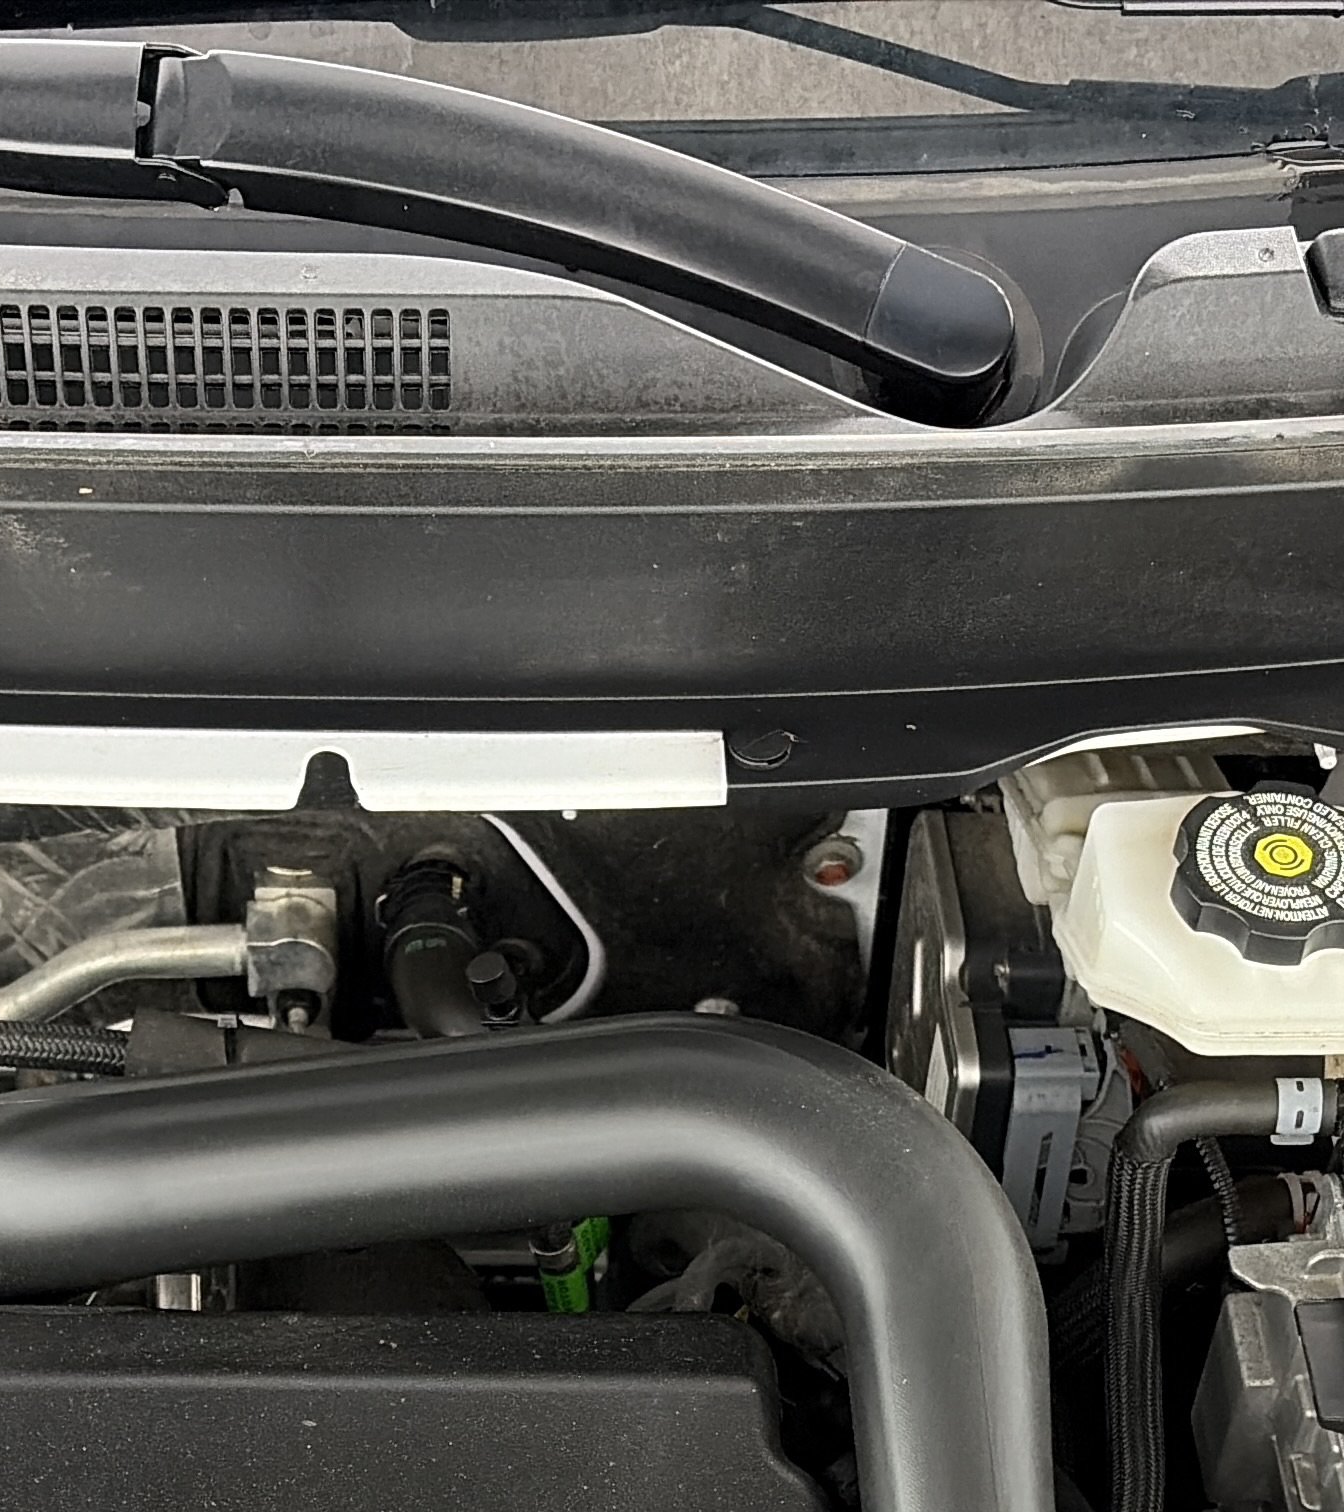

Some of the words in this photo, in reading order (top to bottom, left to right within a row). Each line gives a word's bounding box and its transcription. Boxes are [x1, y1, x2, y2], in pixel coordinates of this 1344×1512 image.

[1256, 804, 1284, 816] ONLY
[1285, 806, 1308, 819] USE
[1262, 816, 1301, 829] FILLER
[1196, 826, 1214, 851] AVANT
[1301, 824, 1332, 848] CLEAN
[1196, 851, 1221, 886] BOUCHON
[1213, 883, 1230, 896] LE
[1241, 887, 1264, 902] QUE
[1250, 883, 1310, 897] PROVENANT
[1325, 880, 1344, 898] CAP
[1225, 891, 1274, 919] NETTOYER
